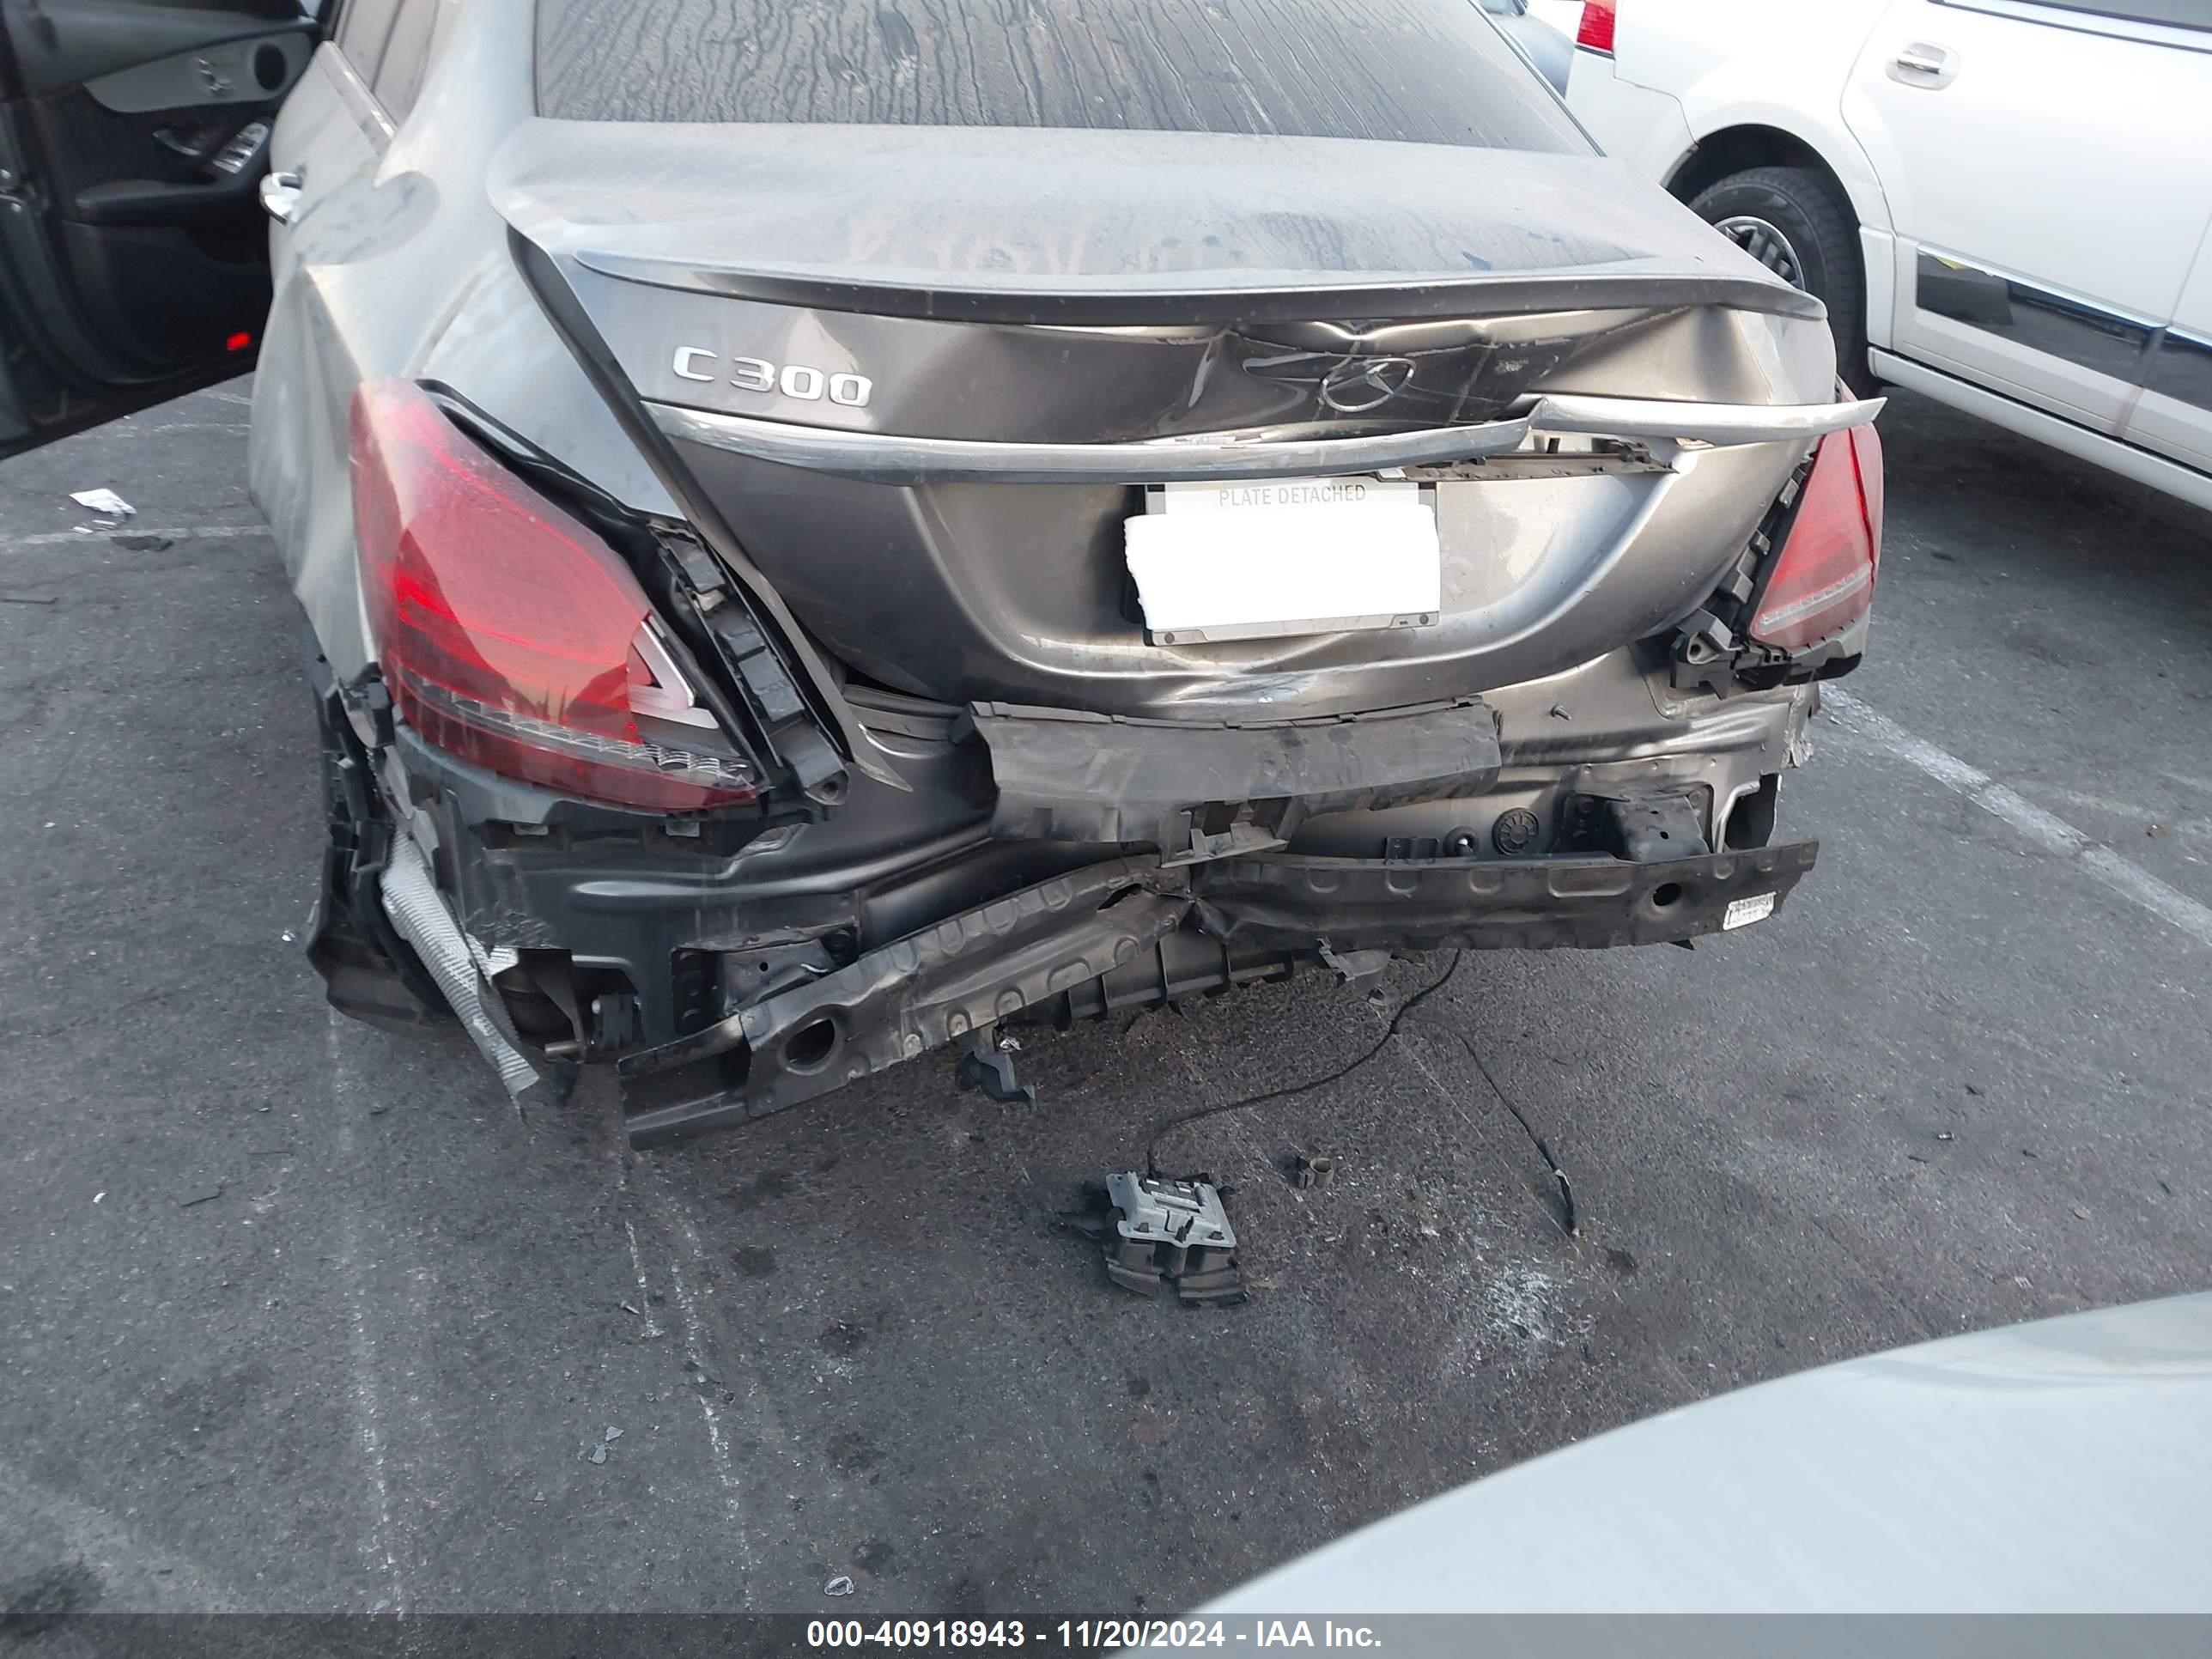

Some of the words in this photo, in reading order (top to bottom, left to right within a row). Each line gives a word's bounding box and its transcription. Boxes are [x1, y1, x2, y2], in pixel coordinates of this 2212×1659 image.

[672, 346, 718, 381] C
[730, 356, 872, 407] 300
[1218, 488, 1272, 507] PLATE
[1278, 483, 1366, 505] DETACHED
